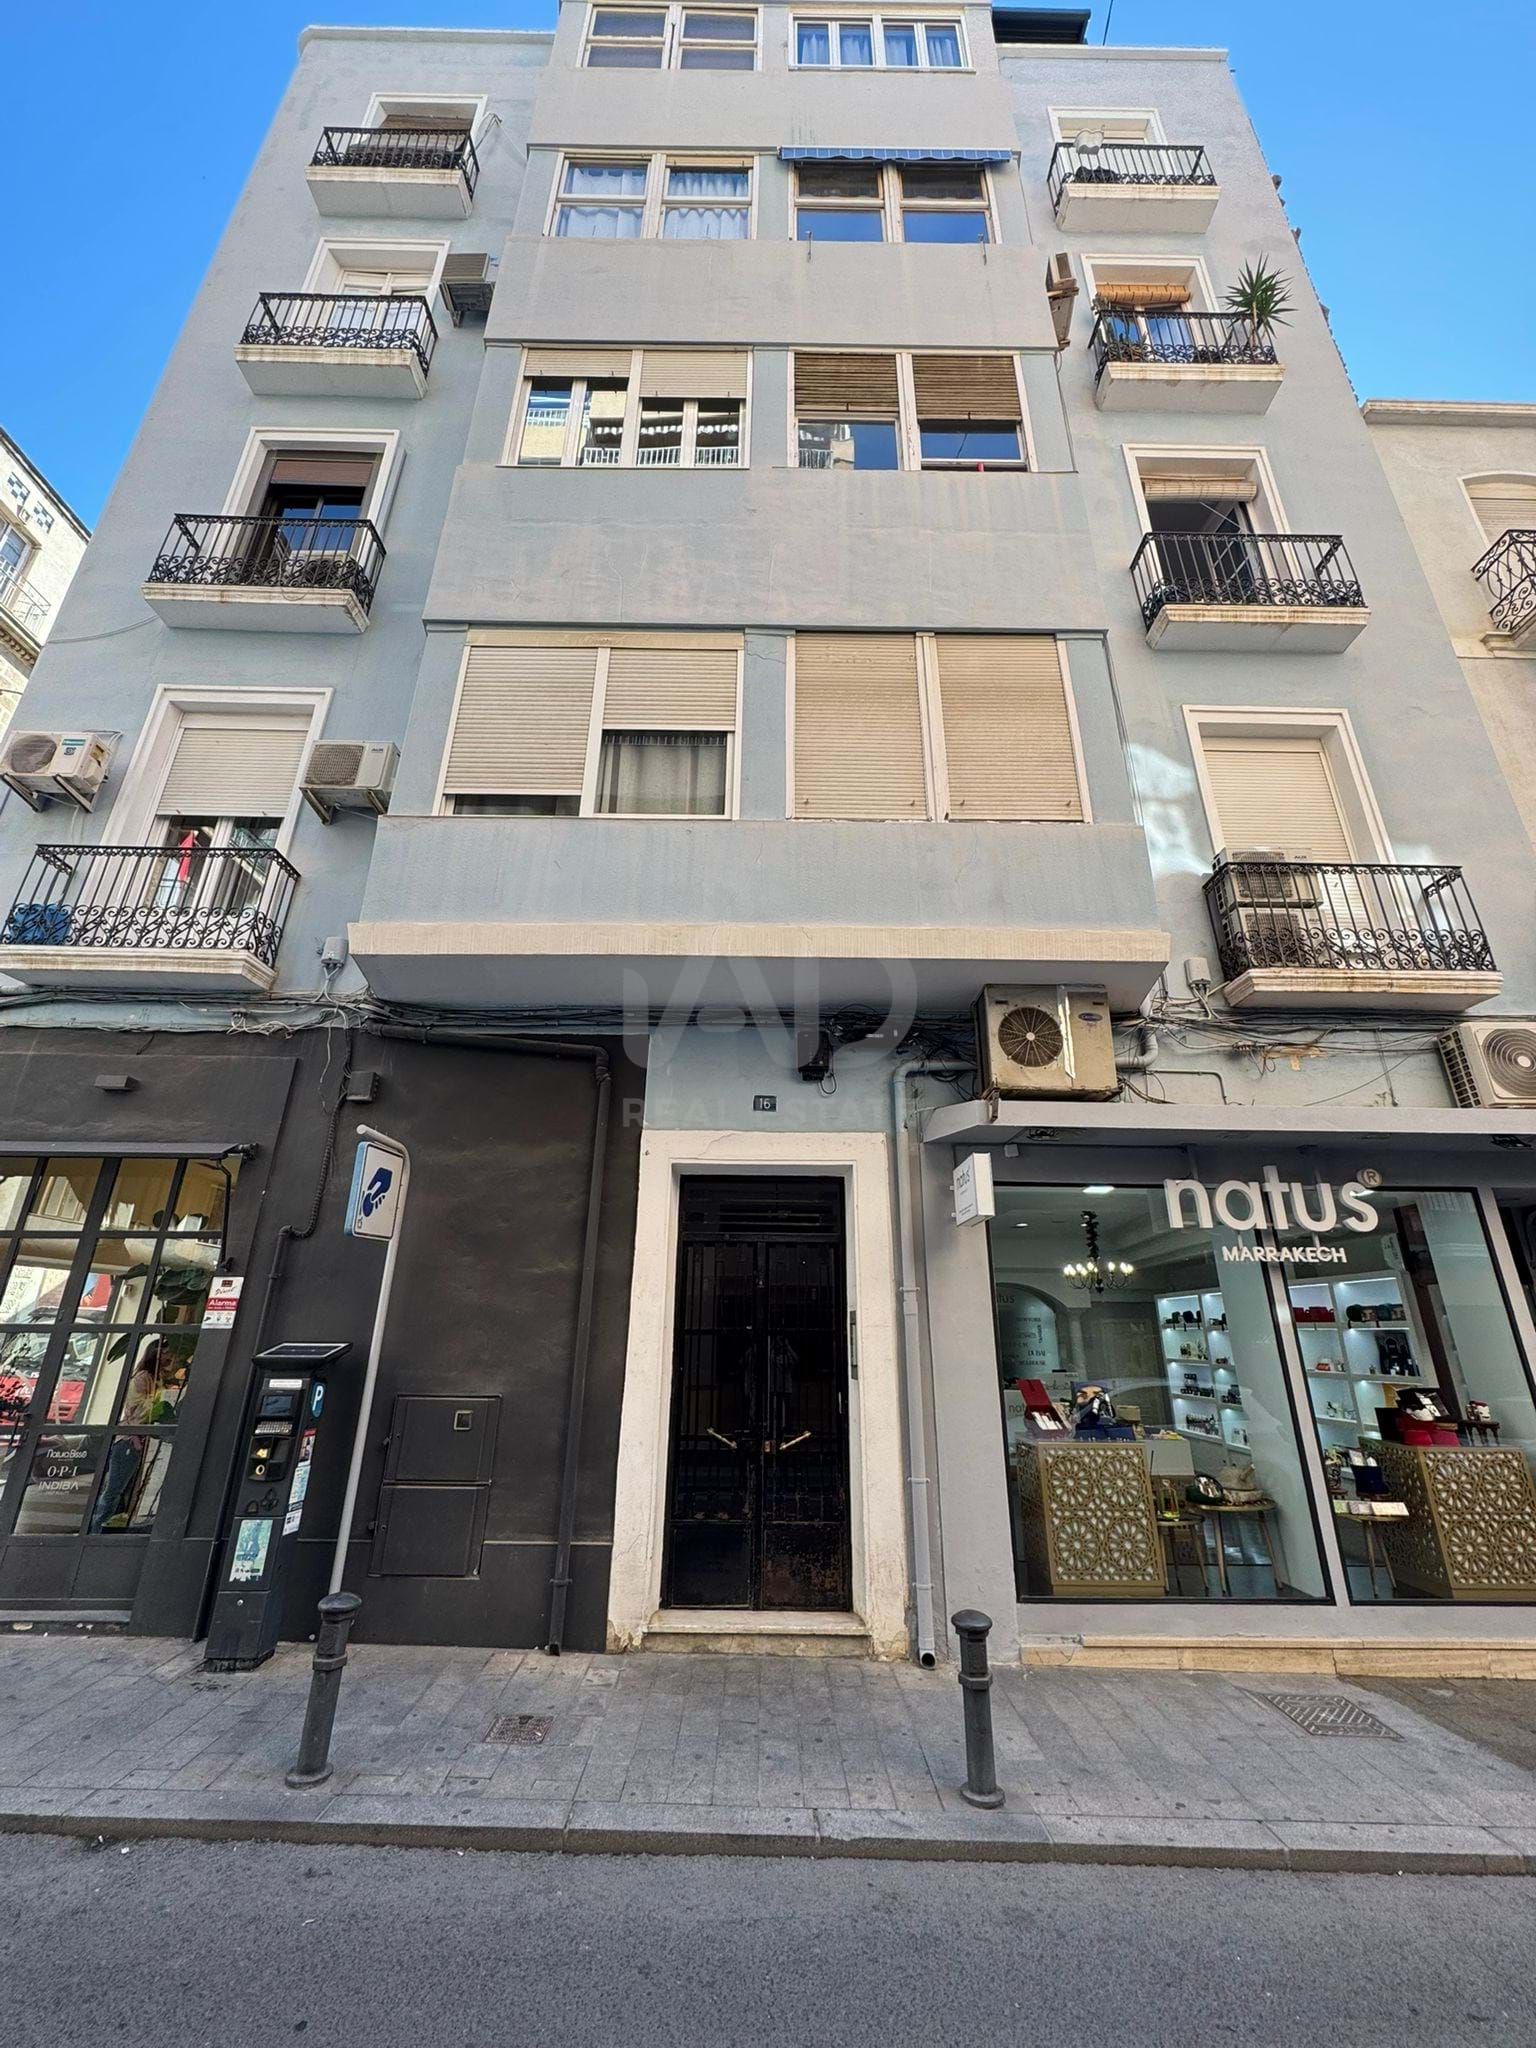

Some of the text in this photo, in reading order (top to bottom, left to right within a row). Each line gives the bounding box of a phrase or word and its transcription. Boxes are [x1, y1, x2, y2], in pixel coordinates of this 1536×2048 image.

[759, 1097, 771, 1110] 16
[1221, 1245, 1348, 1263] MARRAKECH
[313, 1385, 324, 1409] P
[39, 1481, 78, 1490] INDIBA
